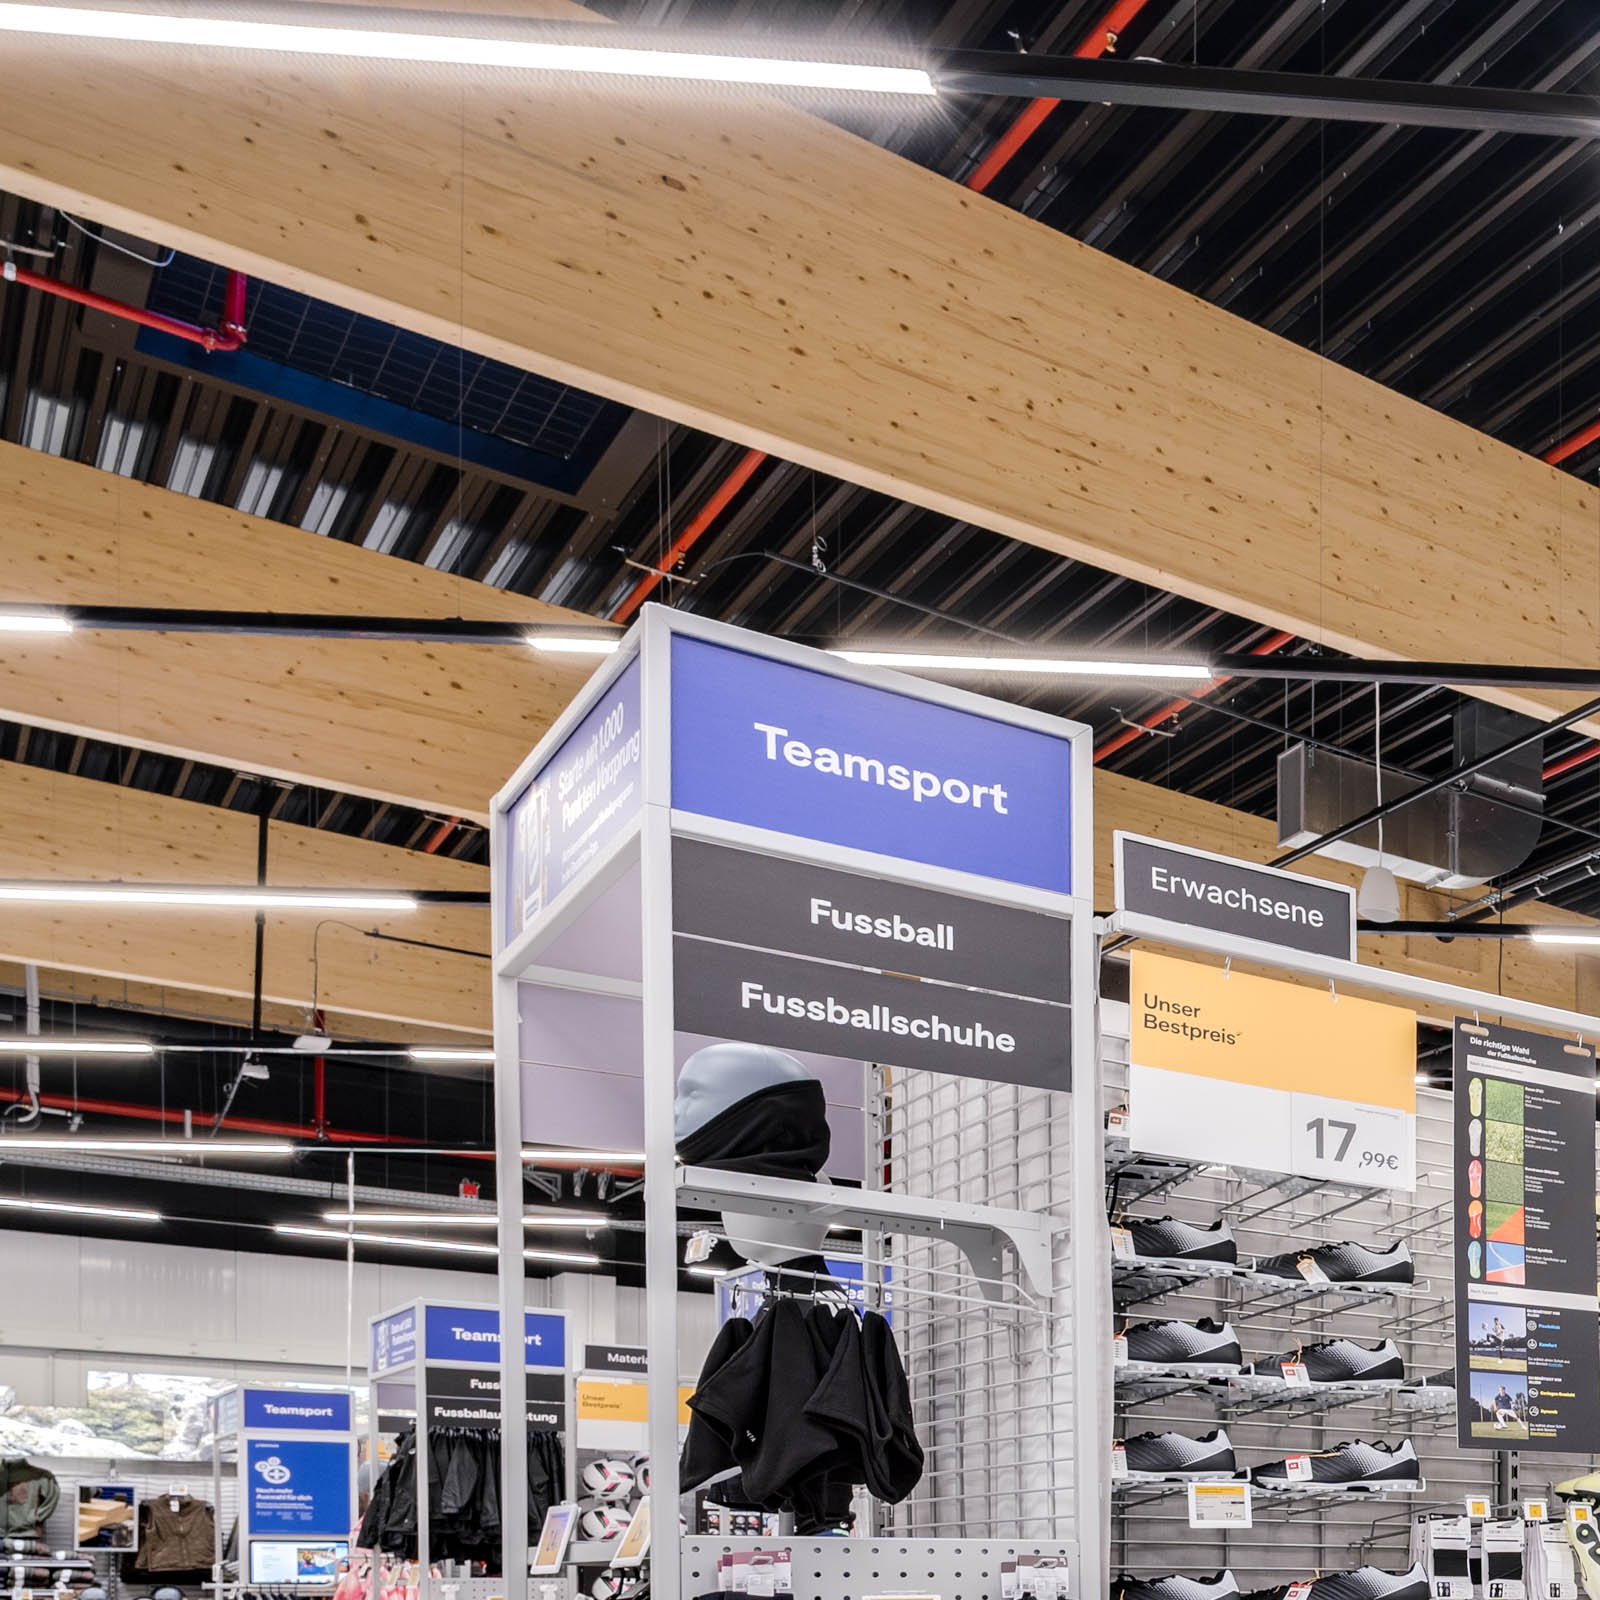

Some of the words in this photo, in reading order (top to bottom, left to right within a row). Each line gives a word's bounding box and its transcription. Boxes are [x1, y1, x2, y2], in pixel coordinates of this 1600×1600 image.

[558, 758, 584, 801] Starte
[599, 702, 625, 750] 1.000
[753, 722, 1009, 815] Teamsport
[562, 783, 597, 832] Punkten
[597, 729, 641, 795] Vorsprung
[1151, 866, 1325, 929] Erwachsene
[810, 897, 955, 951] Fussball
[740, 981, 1016, 1053] Fussballschuhe
[1144, 992, 1201, 1019] Unser
[1469, 1036, 1482, 1046] Die
[1483, 1038, 1511, 1053] richtige
[1511, 1043, 1530, 1056] Wahl
[451, 1326, 543, 1348] Teamsort
[607, 1352, 649, 1365] Materia
[263, 1403, 334, 1418] Teamsport
[1225, 1512, 1233, 1520] 17
